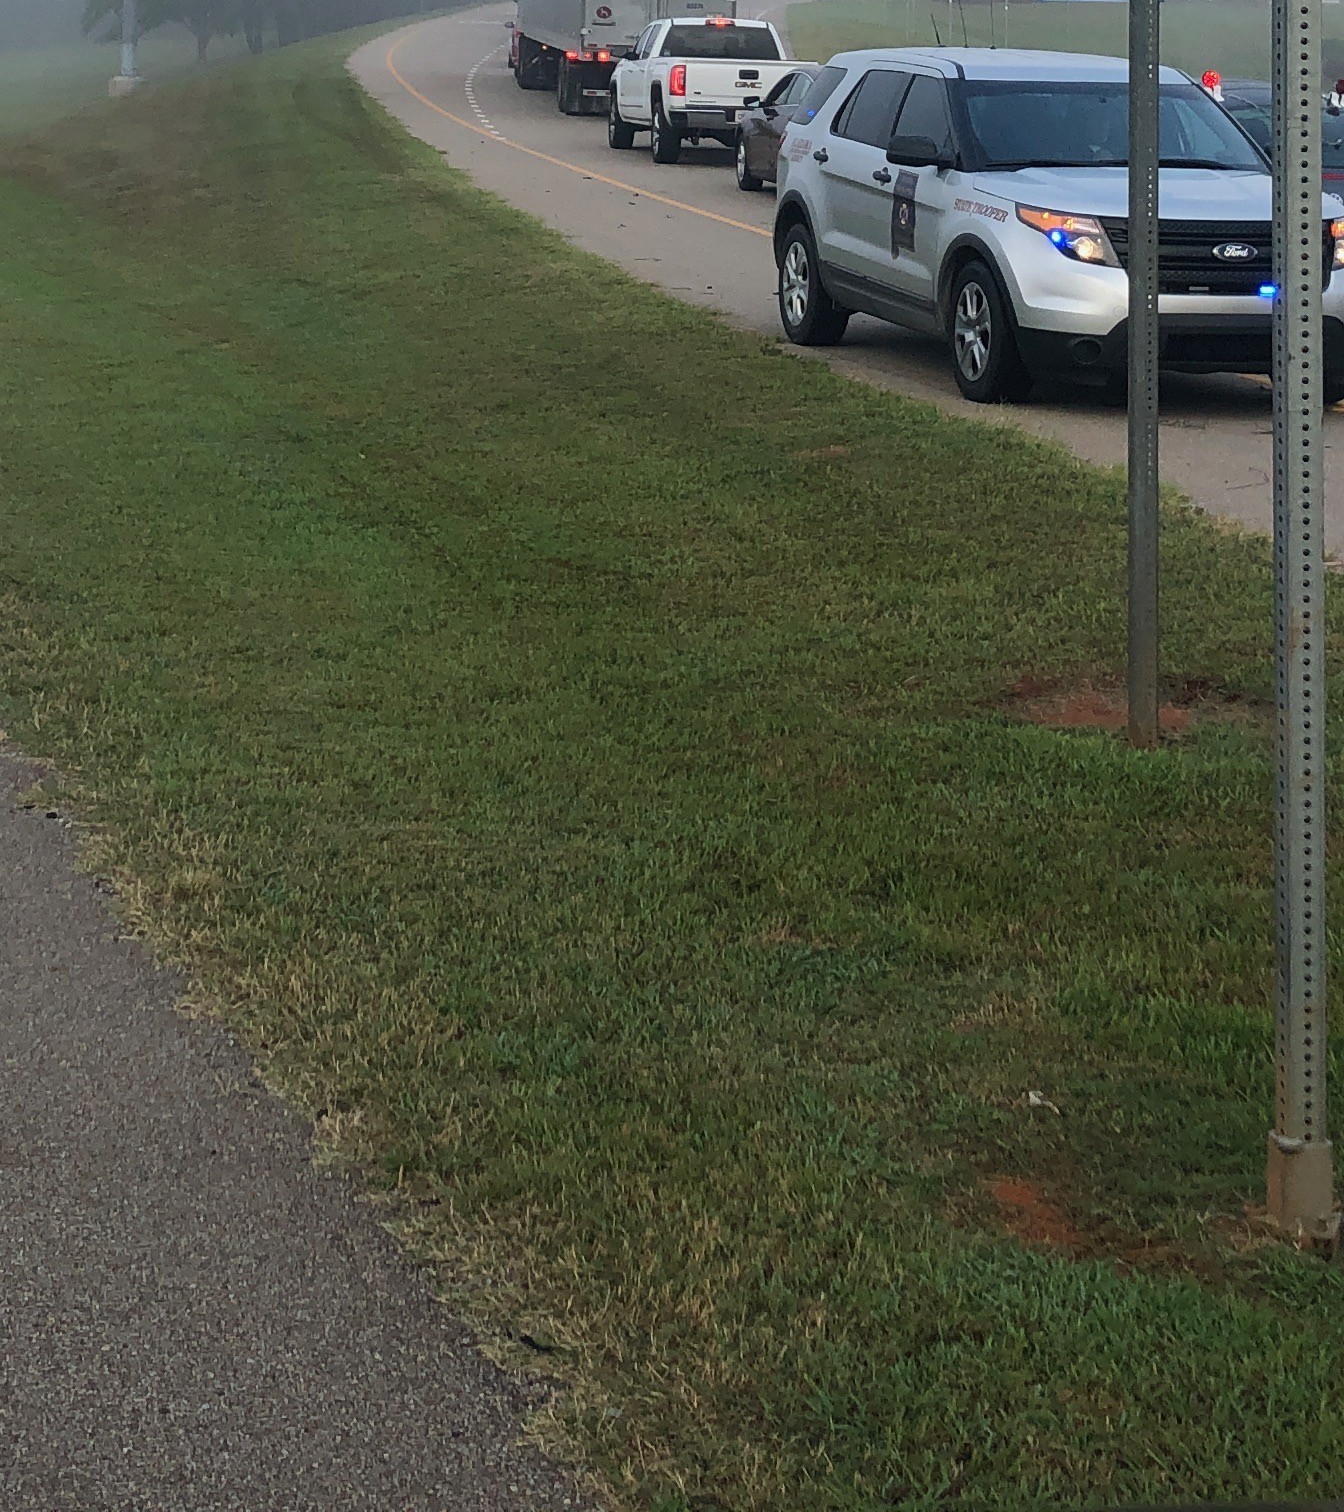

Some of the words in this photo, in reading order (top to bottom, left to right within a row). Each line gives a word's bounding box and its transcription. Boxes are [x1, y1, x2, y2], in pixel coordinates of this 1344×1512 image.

[735, 81, 763, 89] GMC
[972, 201, 1009, 223] TROOPER
[1223, 244, 1249, 257] Ford
